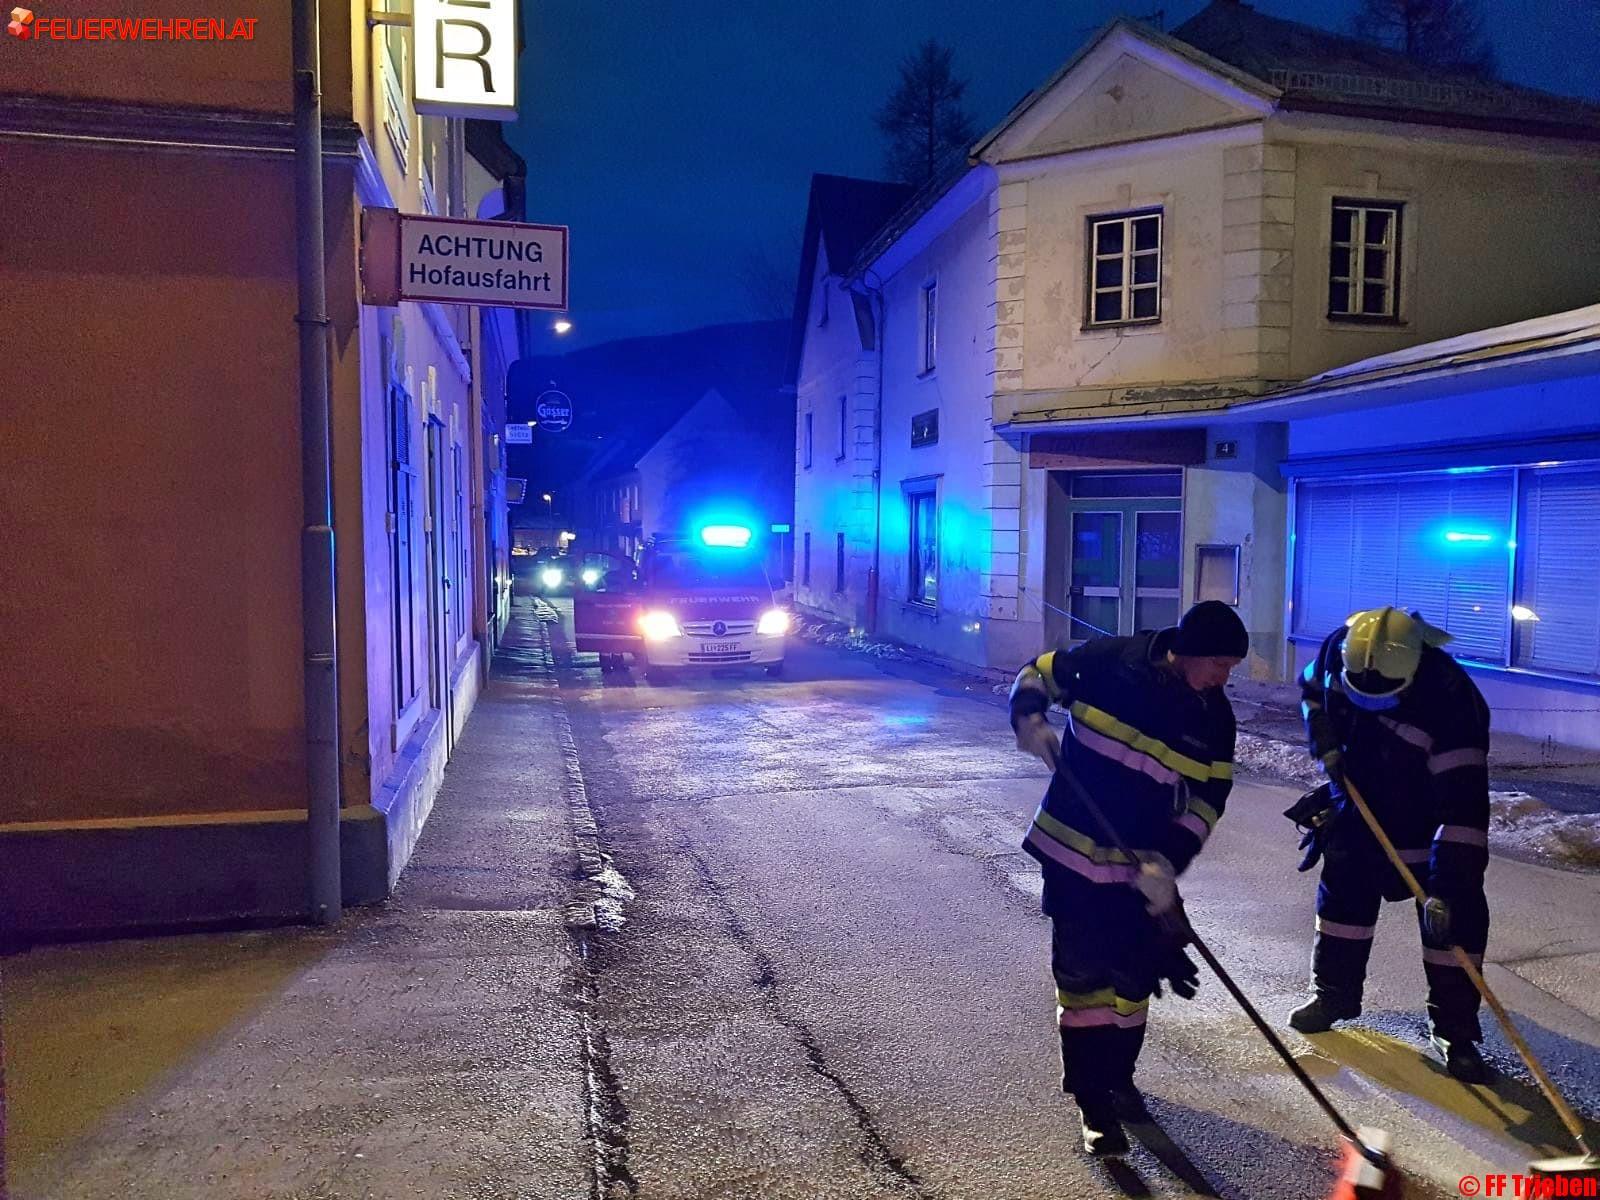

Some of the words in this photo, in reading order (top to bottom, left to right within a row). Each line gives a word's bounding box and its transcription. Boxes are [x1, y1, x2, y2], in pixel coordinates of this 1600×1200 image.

[435, 0, 496, 93] R
[418, 234, 543, 263] ACHTUNG
[409, 262, 551, 292] Hofausfahrt
[1221, 443, 1229, 454] 4
